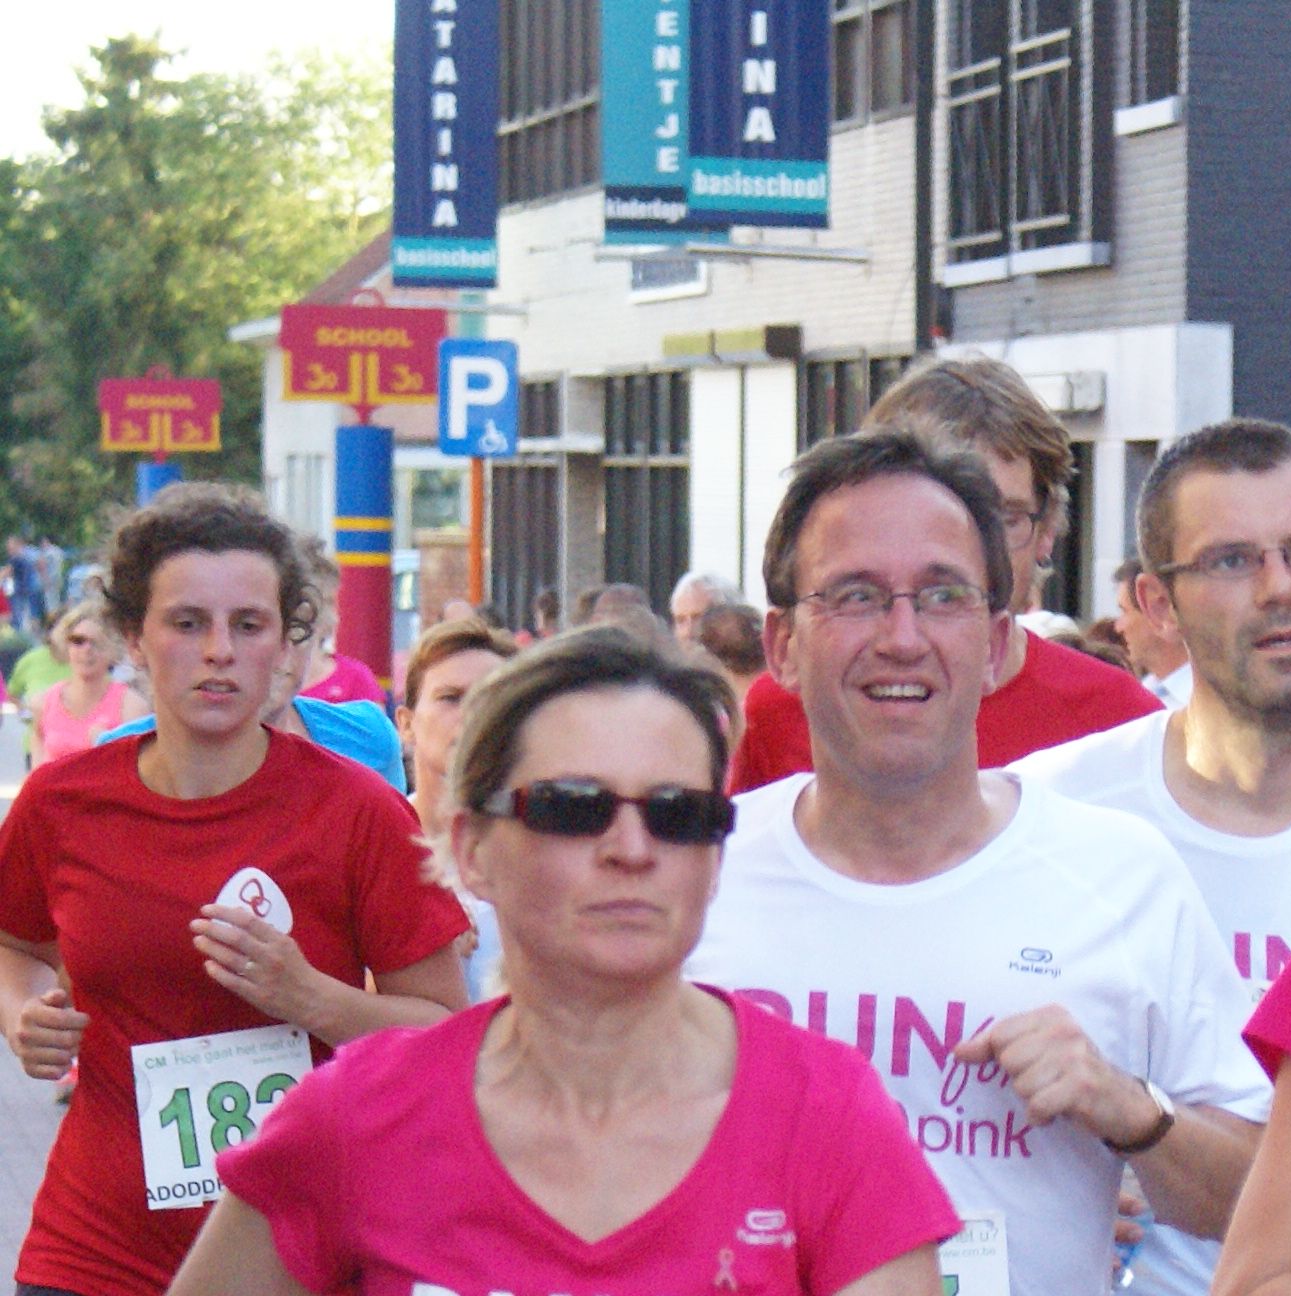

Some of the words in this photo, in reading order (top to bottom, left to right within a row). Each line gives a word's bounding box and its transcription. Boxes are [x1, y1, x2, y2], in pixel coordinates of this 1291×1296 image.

[653, 0, 682, 174] ENTJE
[692, 169, 827, 199] basisschool
[315, 326, 414, 348] SCHOOL
[449, 356, 509, 440] P
